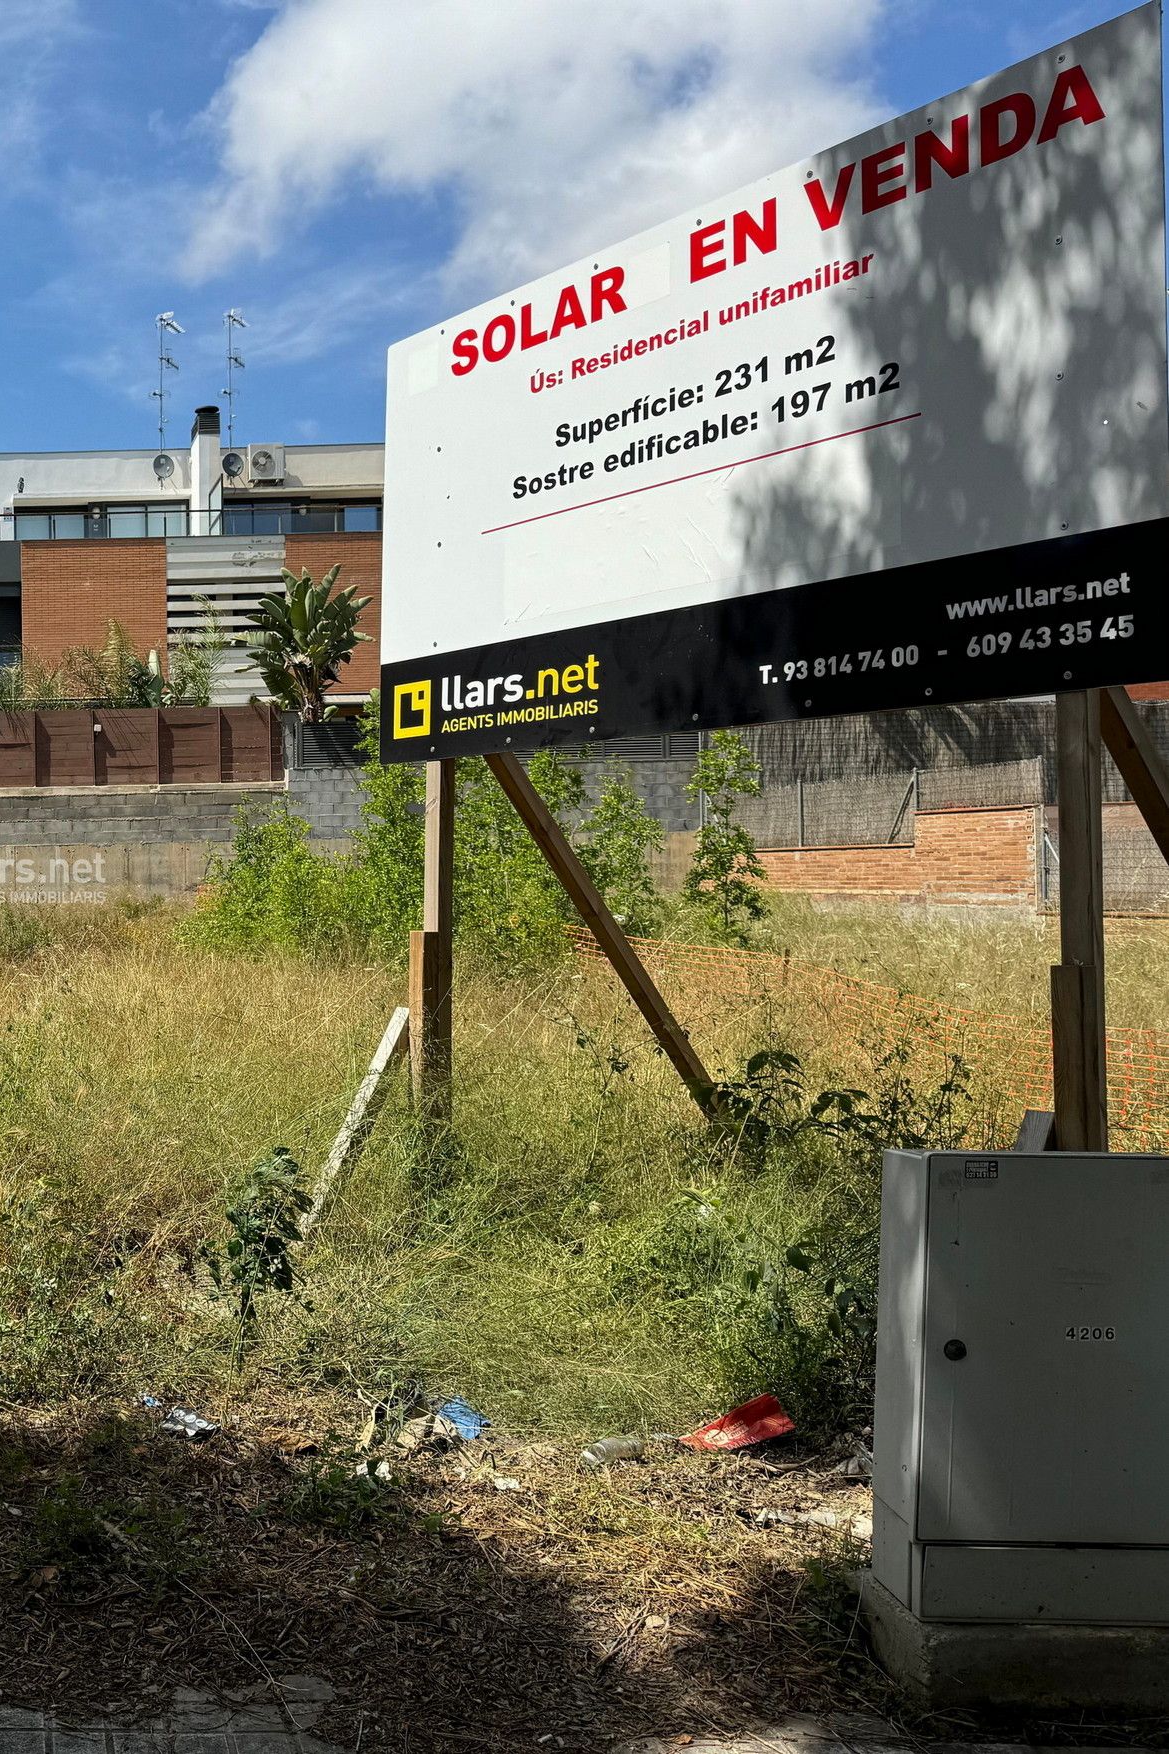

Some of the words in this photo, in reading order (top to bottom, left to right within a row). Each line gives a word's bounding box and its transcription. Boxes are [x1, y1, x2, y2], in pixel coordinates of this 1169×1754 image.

[451, 266, 628, 377] SOLAR
[689, 197, 777, 283] EN
[803, 64, 1106, 231] VENDA
[530, 368, 563, 394] Ús:
[571, 310, 709, 379] Residencial
[719, 254, 874, 326] unifamiliar
[555, 384, 704, 447] Superfície:
[715, 355, 768, 398] 231
[785, 335, 836, 376] m2
[512, 461, 594, 499] Sostre
[603, 411, 758, 473] edificable:
[771, 381, 831, 423] 197
[845, 362, 900, 403] m2
[946, 572, 1131, 620] www.llars.net
[441, 654, 600, 712] llars.net
[758, 664, 779, 685] T.
[783, 660, 808, 682] 93
[813, 653, 853, 678] 814
[858, 649, 886, 671] 74
[891, 644, 919, 666] 00
[966, 631, 1012, 658] 609
[1019, 625, 1052, 651] 43
[1059, 620, 1092, 645] 35
[1100, 614, 1135, 640] 45
[441, 713, 494, 734] AGENTS
[497, 699, 599, 727] IMMOBILIARIS
[1066, 1327, 1116, 1341] 4206
